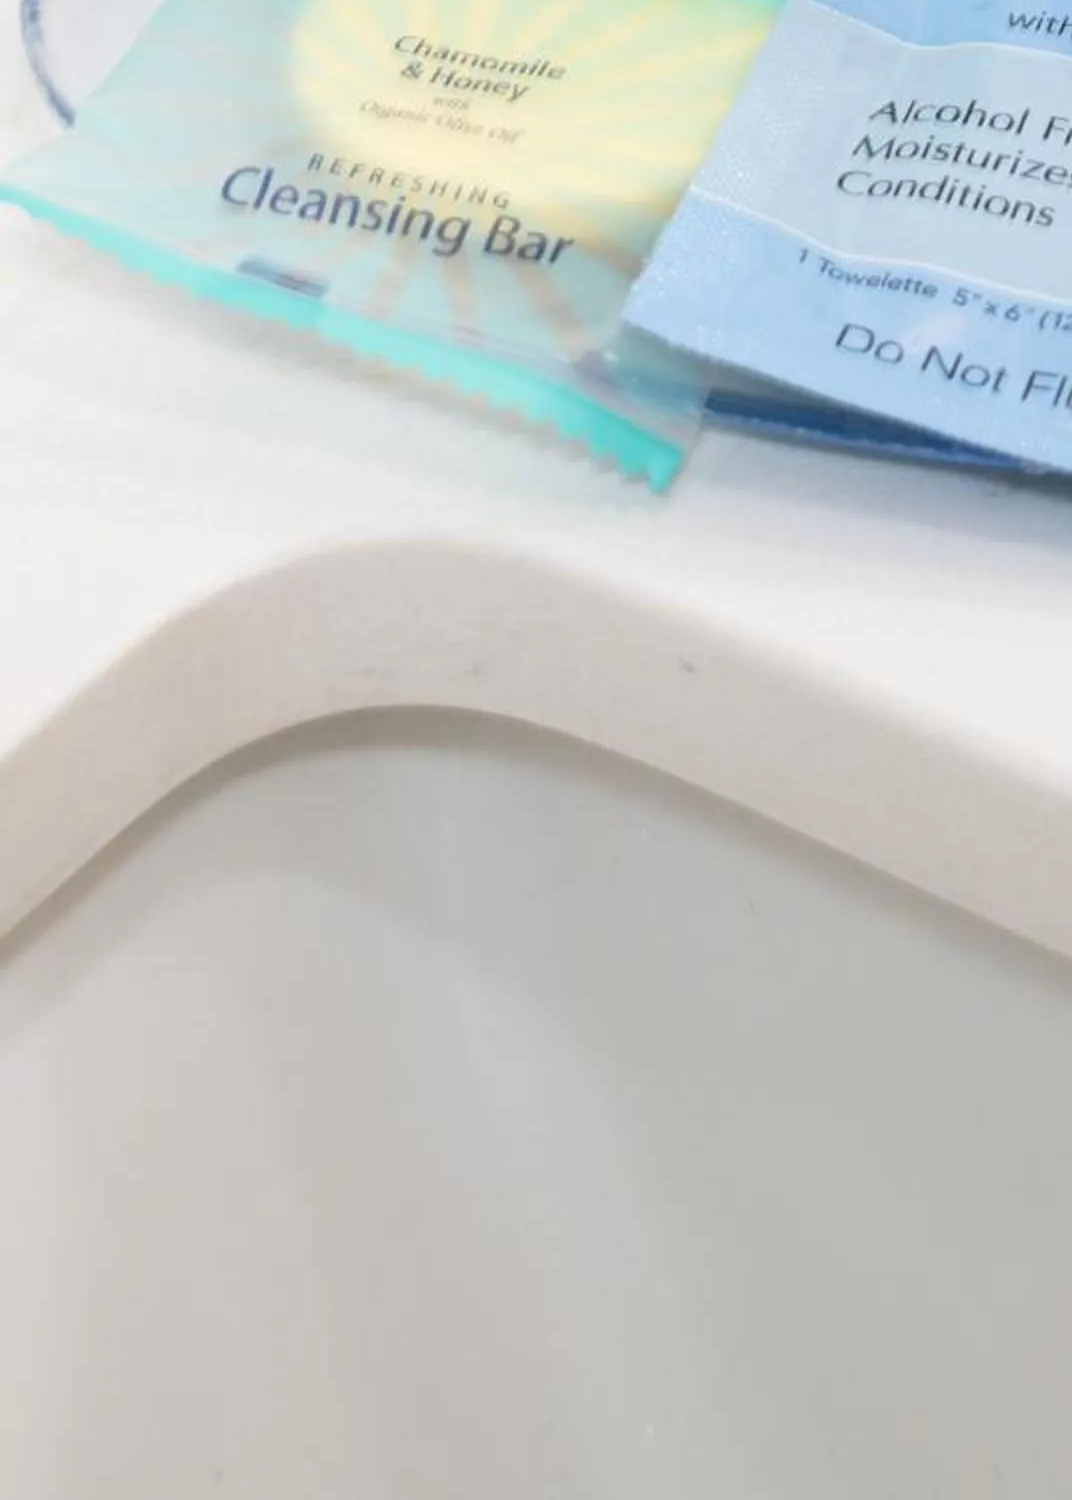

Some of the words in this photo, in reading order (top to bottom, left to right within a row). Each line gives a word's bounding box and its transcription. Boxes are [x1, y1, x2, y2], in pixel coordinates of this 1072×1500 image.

[394, 34, 567, 81] Chamomile
[400, 59, 425, 80] &
[429, 65, 532, 104] Honey
[868, 98, 1031, 138] Alcohol
[307, 151, 514, 211] REFRESHING
[835, 168, 1058, 229] Conditions
[220, 163, 472, 258] Cleansing
[481, 212, 575, 268] Bar
[799, 247, 808, 264] 1
[818, 256, 939, 299] Towelette
[983, 301, 999, 317] x
[833, 323, 906, 365] Do
[920, 344, 1007, 394] Not
